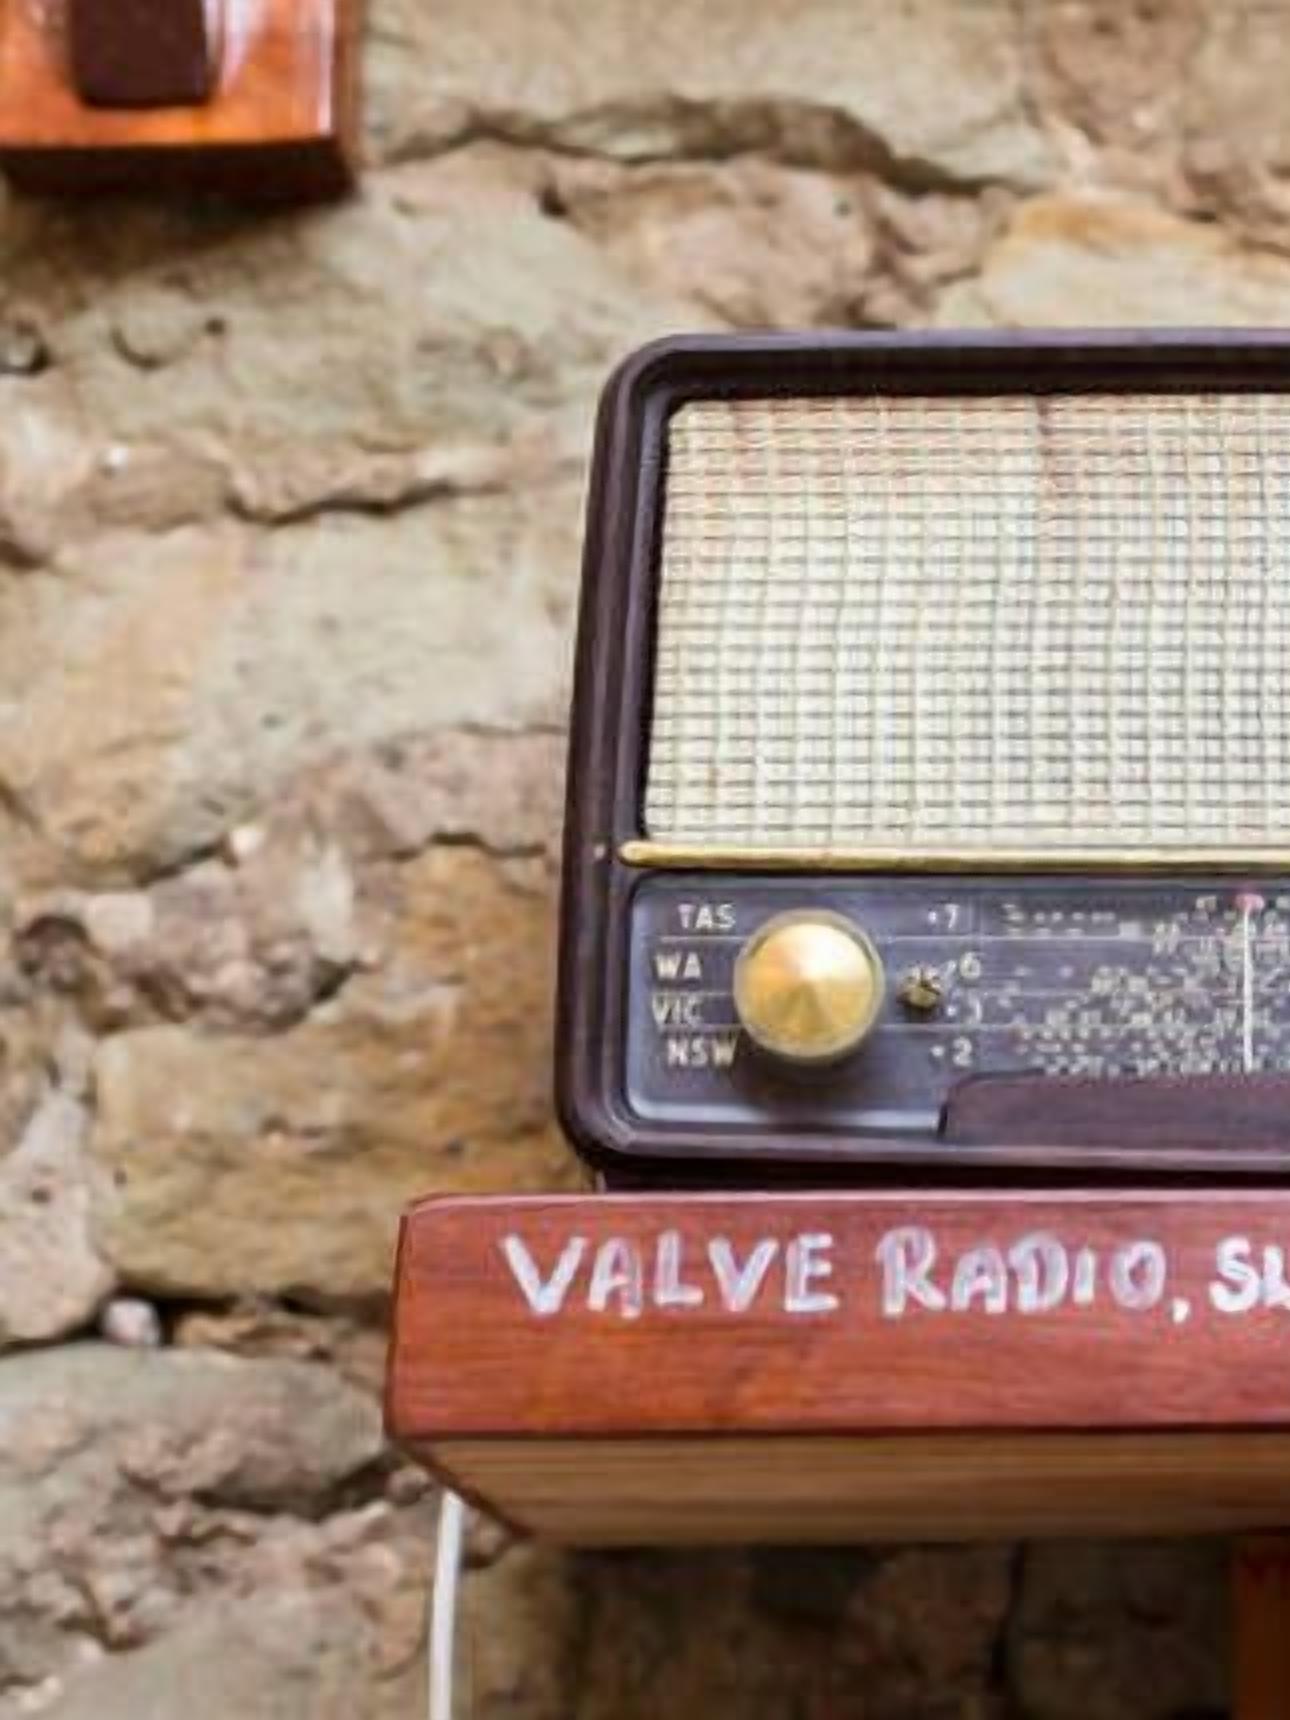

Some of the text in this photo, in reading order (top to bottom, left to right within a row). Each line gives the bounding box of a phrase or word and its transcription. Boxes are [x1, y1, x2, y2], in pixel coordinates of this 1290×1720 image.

[678, 903, 736, 929] TAS
[654, 951, 702, 980] WA
[959, 951, 981, 980] 6
[651, 992, 703, 1030] VIC
[667, 1034, 739, 1067] NSW
[952, 1036, 973, 1066] 2
[503, 1228, 839, 1319] VALVE
